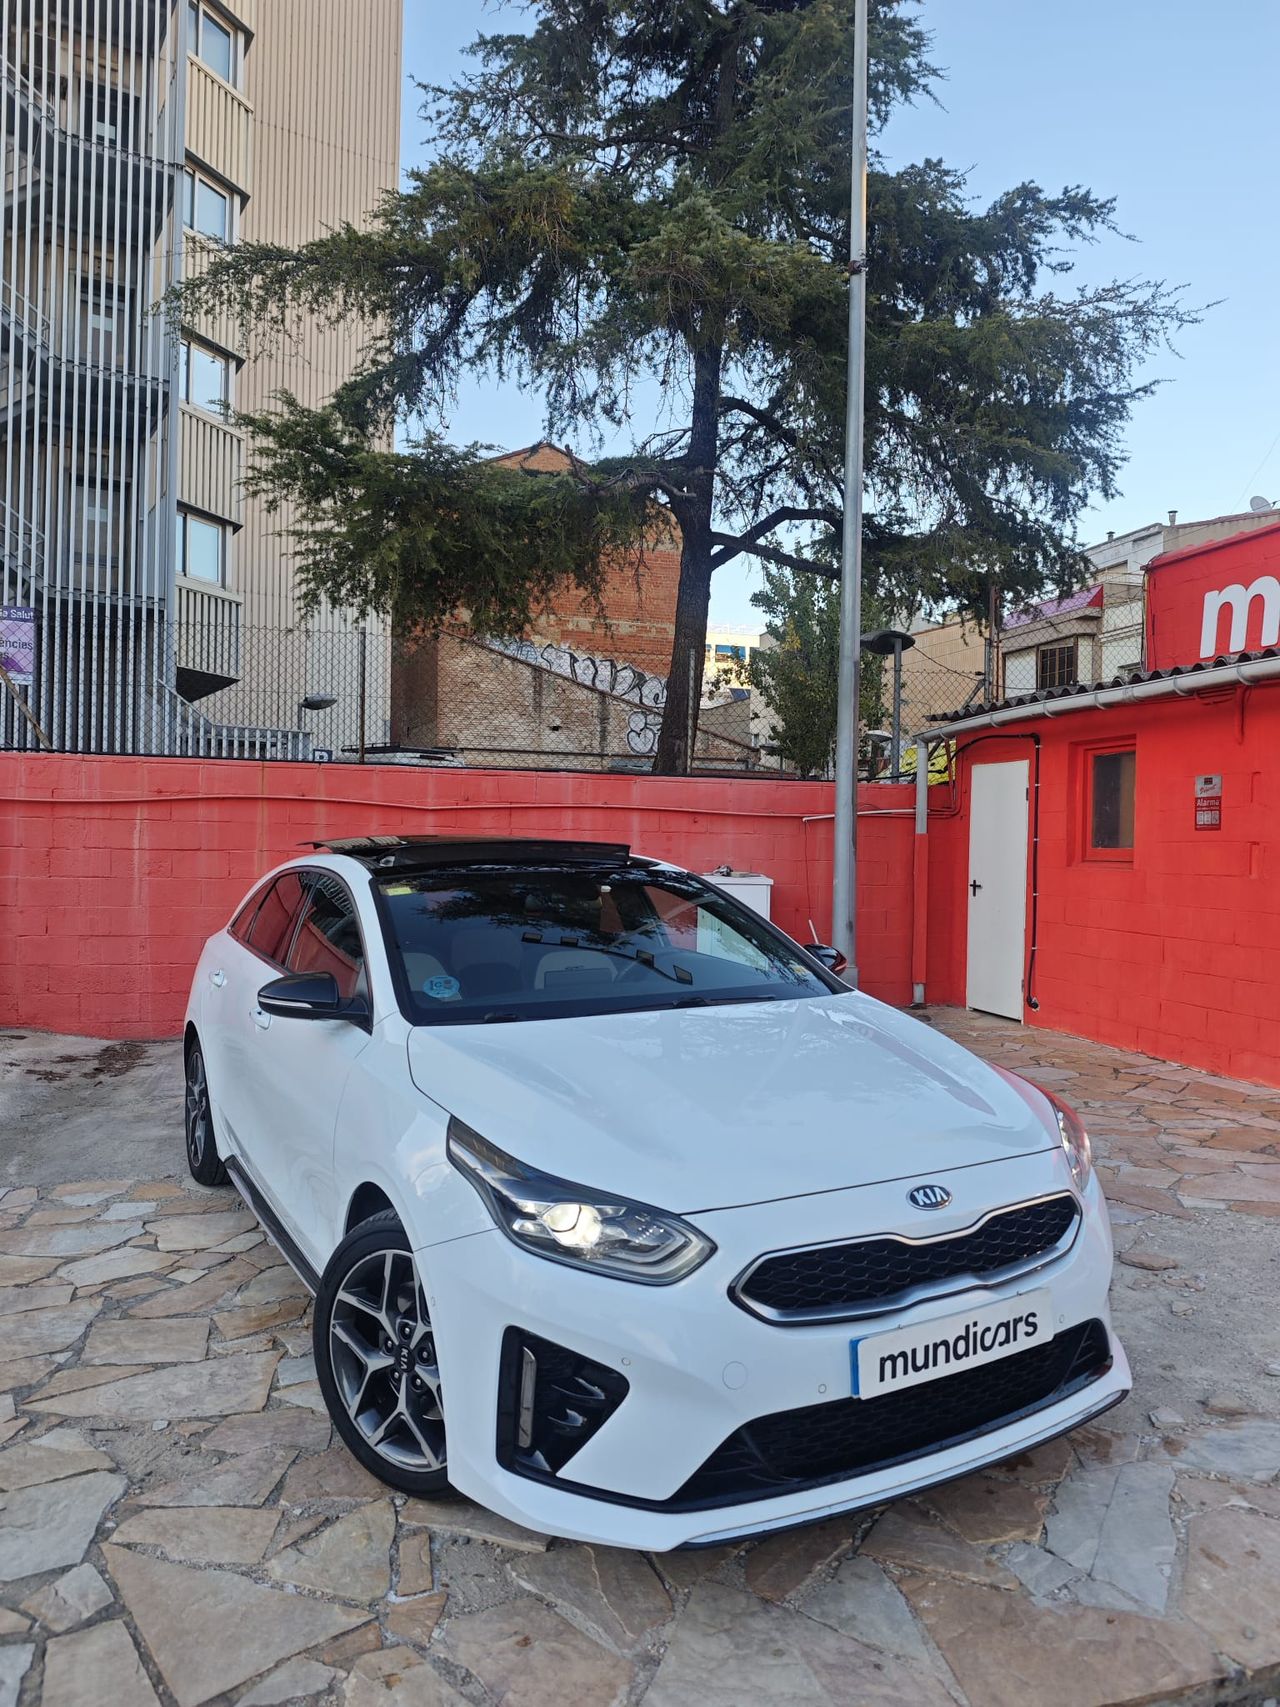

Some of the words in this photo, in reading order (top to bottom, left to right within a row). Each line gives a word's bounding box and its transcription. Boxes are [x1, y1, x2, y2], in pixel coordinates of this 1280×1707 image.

[10, 609, 34, 620] Salut
[912, 1186, 949, 1206] KIA
[878, 1311, 1038, 1383] mundicars
[400, 1348, 408, 1369] KIA
